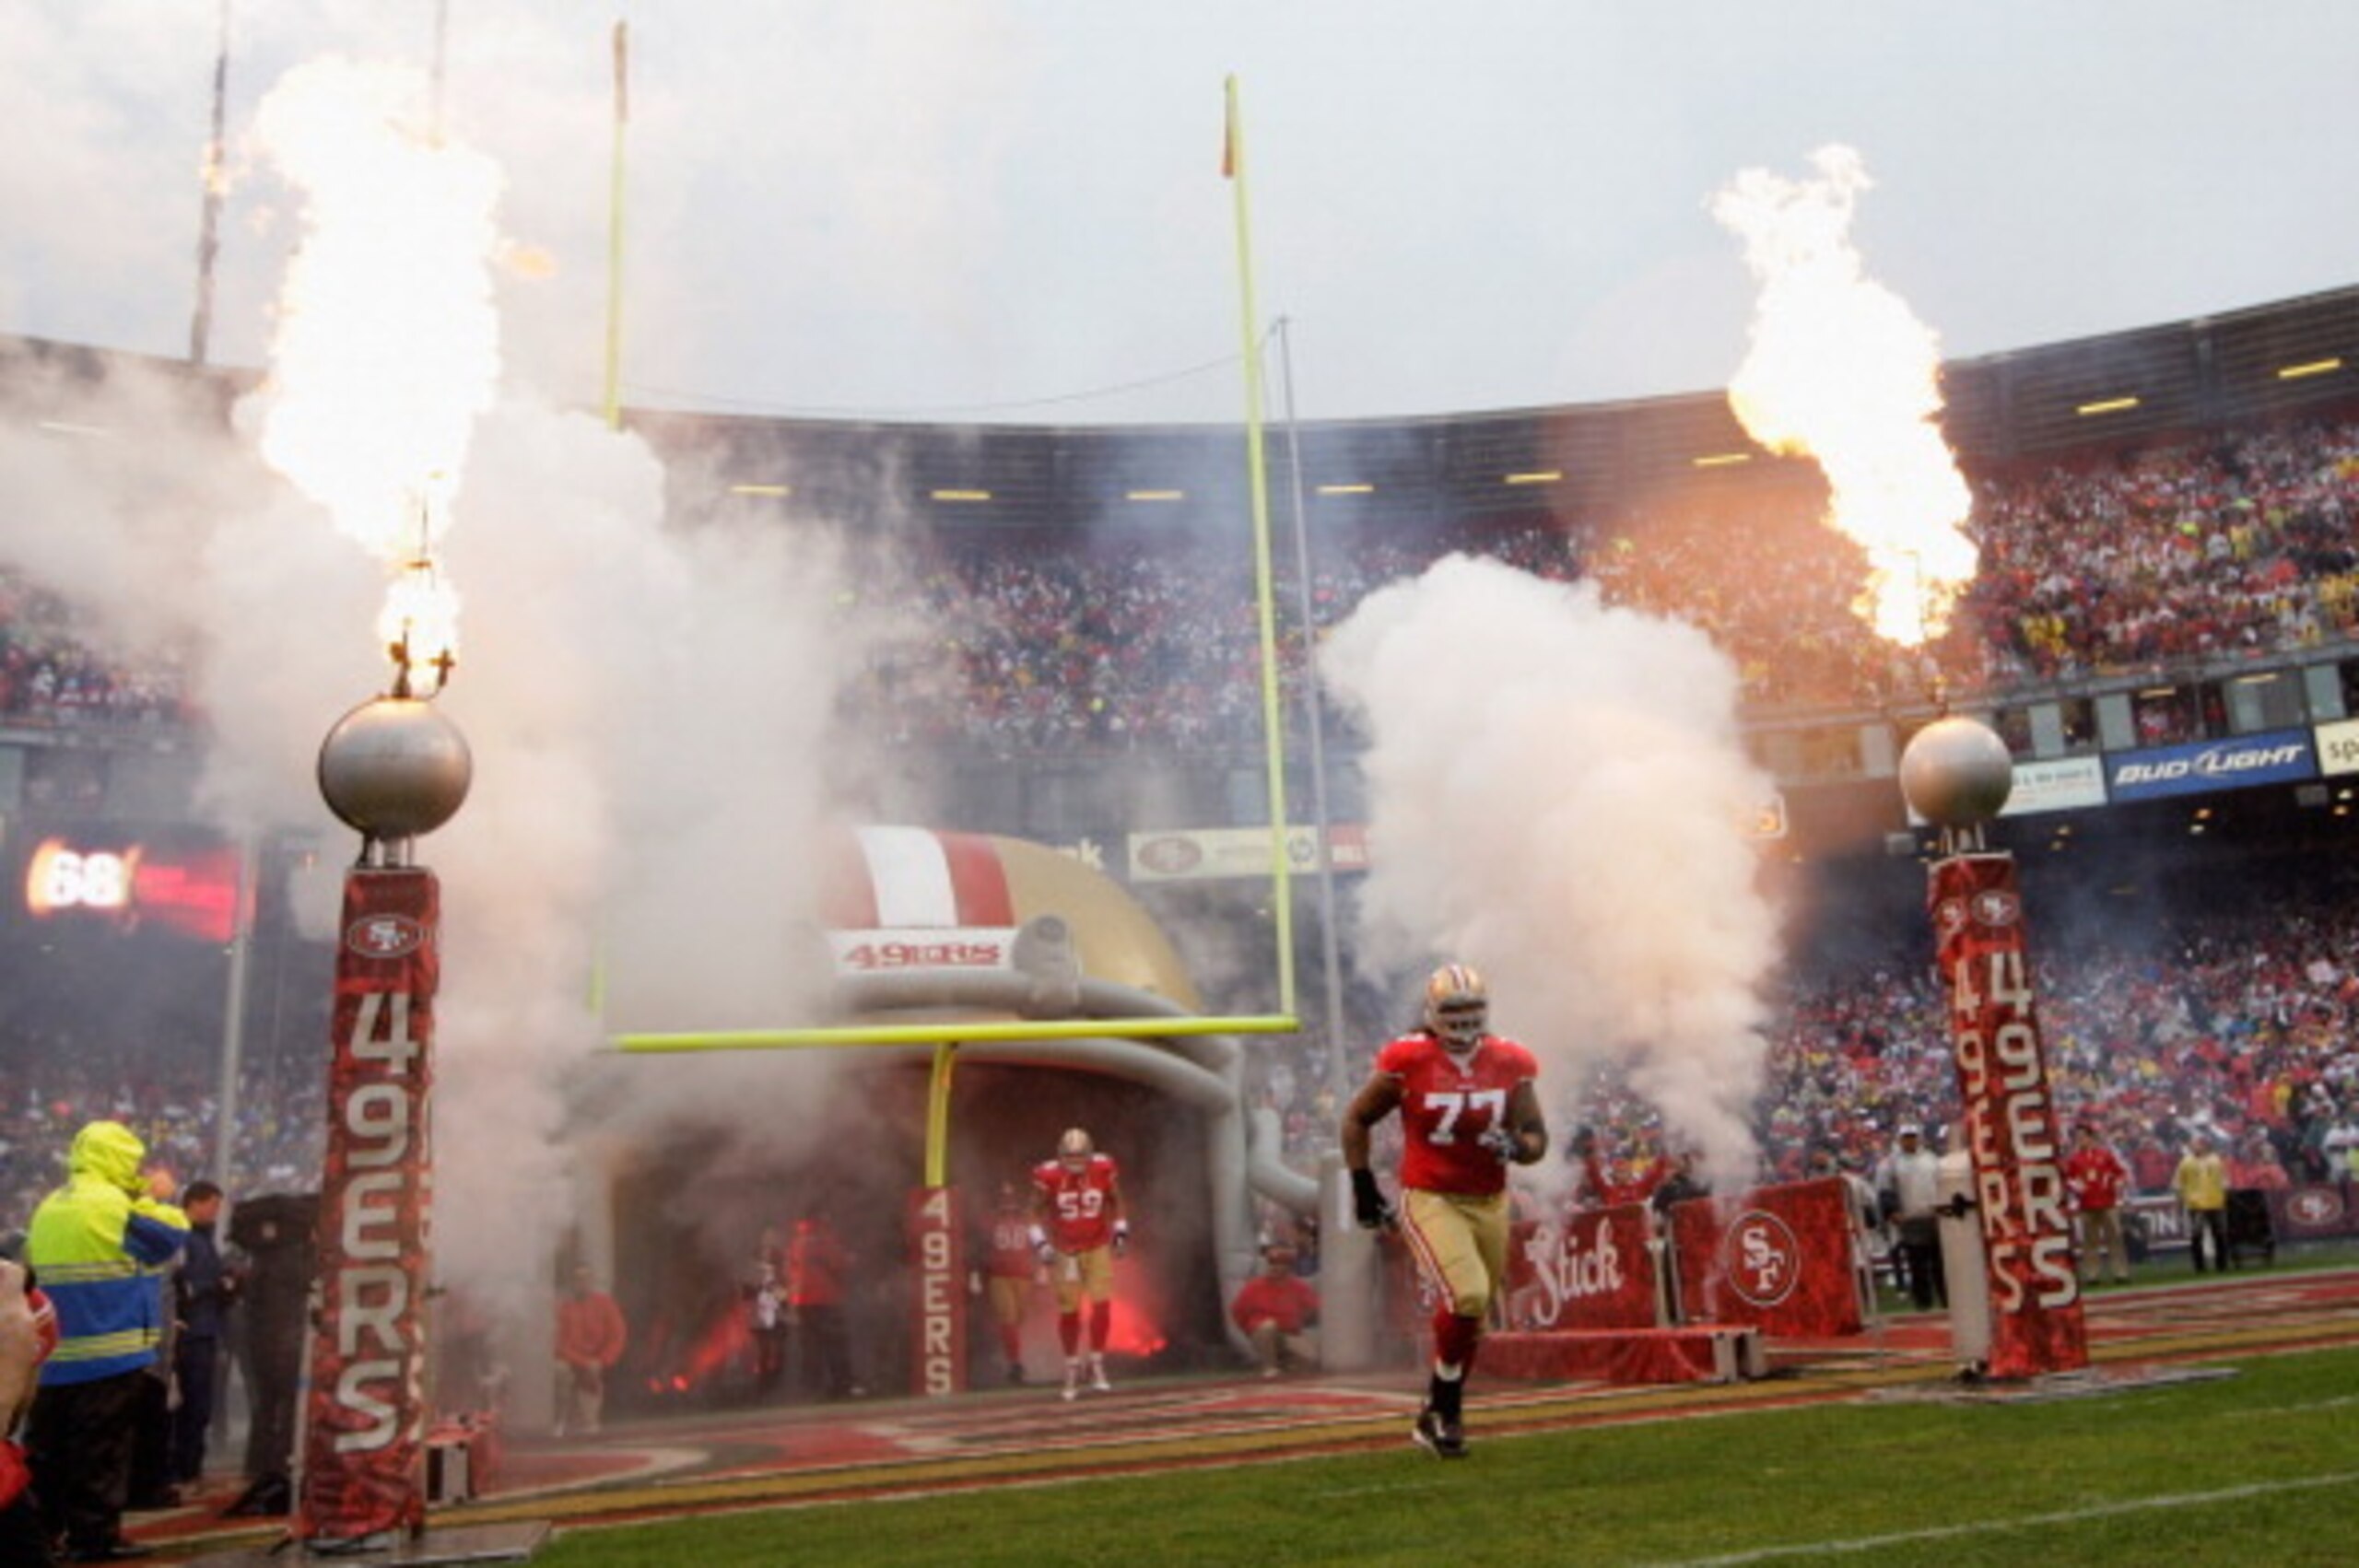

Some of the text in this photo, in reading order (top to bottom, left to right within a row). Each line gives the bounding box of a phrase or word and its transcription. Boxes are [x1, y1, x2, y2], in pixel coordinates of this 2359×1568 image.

[2115, 760, 2190, 785] BUD
[2202, 744, 2305, 773] LIGHT
[46, 849, 125, 908] 68
[1424, 1089, 1506, 1145] 77
[1954, 961, 2023, 1312] 49ERS
[1990, 951, 2077, 1308] 49ERS
[335, 992, 418, 1453] 49ERS
[1057, 1188, 1103, 1221] 59
[922, 1190, 952, 1395] 49ERS
[1524, 1217, 1622, 1326] Stick
